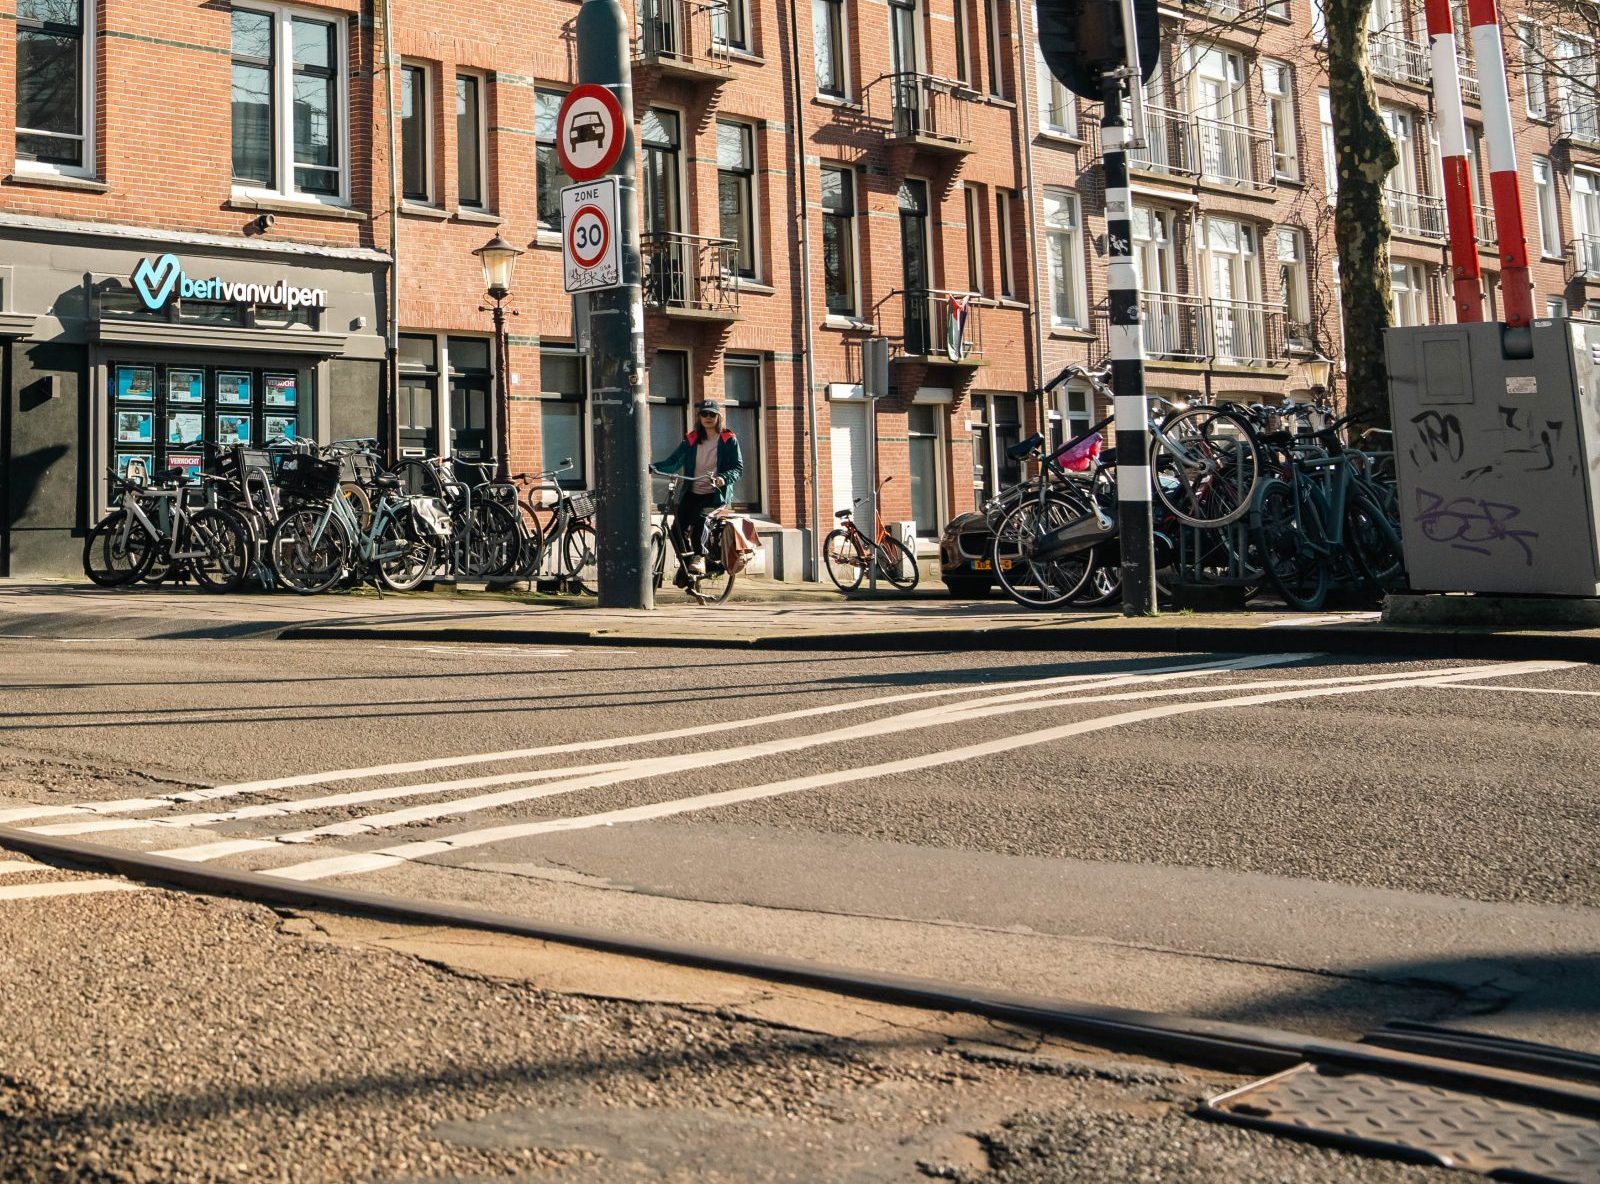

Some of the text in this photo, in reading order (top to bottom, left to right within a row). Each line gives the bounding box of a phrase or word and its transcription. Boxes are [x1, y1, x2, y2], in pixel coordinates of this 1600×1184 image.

[574, 188, 600, 202] ZONE
[576, 224, 601, 249] 30
[180, 272, 324, 311] bertvanvulpen
[170, 457, 200, 465] VERKOCHT
